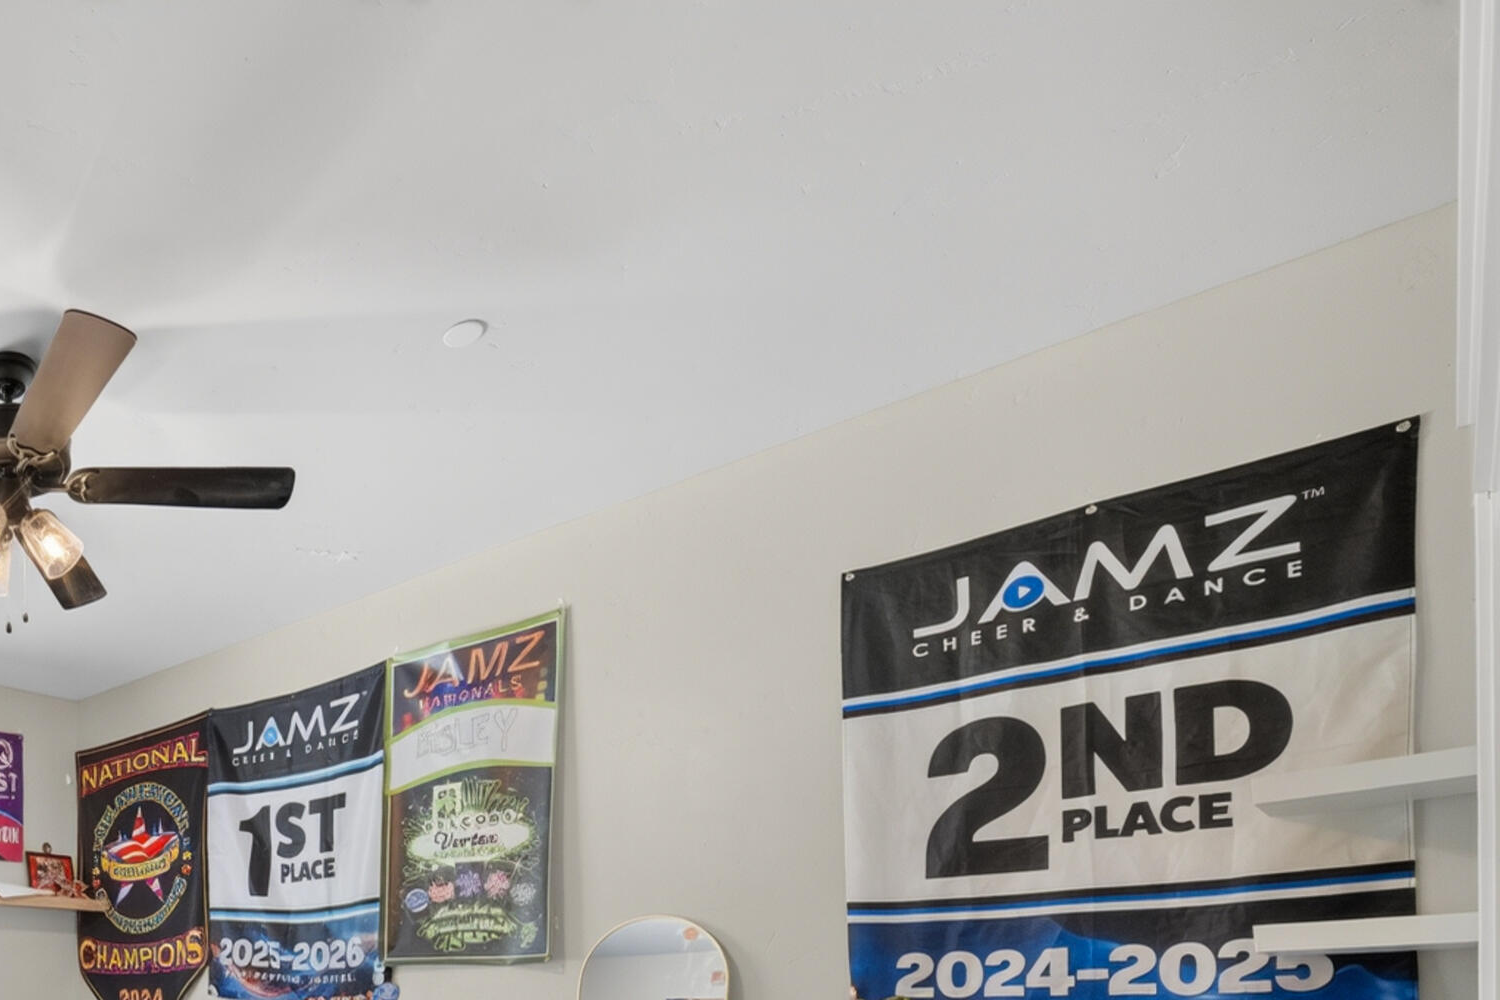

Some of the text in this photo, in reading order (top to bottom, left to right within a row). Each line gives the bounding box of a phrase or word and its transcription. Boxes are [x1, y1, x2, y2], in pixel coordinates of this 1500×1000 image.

[913, 494, 1301, 639] JAMZ
[913, 558, 1303, 658] CHEER & DANCE
[404, 630, 545, 698] JAMZ
[232, 693, 361, 755] JAMZ
[80, 733, 208, 797] NATIONAL
[925, 679, 1294, 879] 2ND
[238, 792, 347, 897] 1ST
[1061, 791, 1234, 843] PLACE
[280, 857, 336, 884] PLACE
[79, 928, 205, 972] CHAMPIONS
[219, 935, 365, 972] 2025-2026
[895, 938, 1335, 999] 2024-2025
